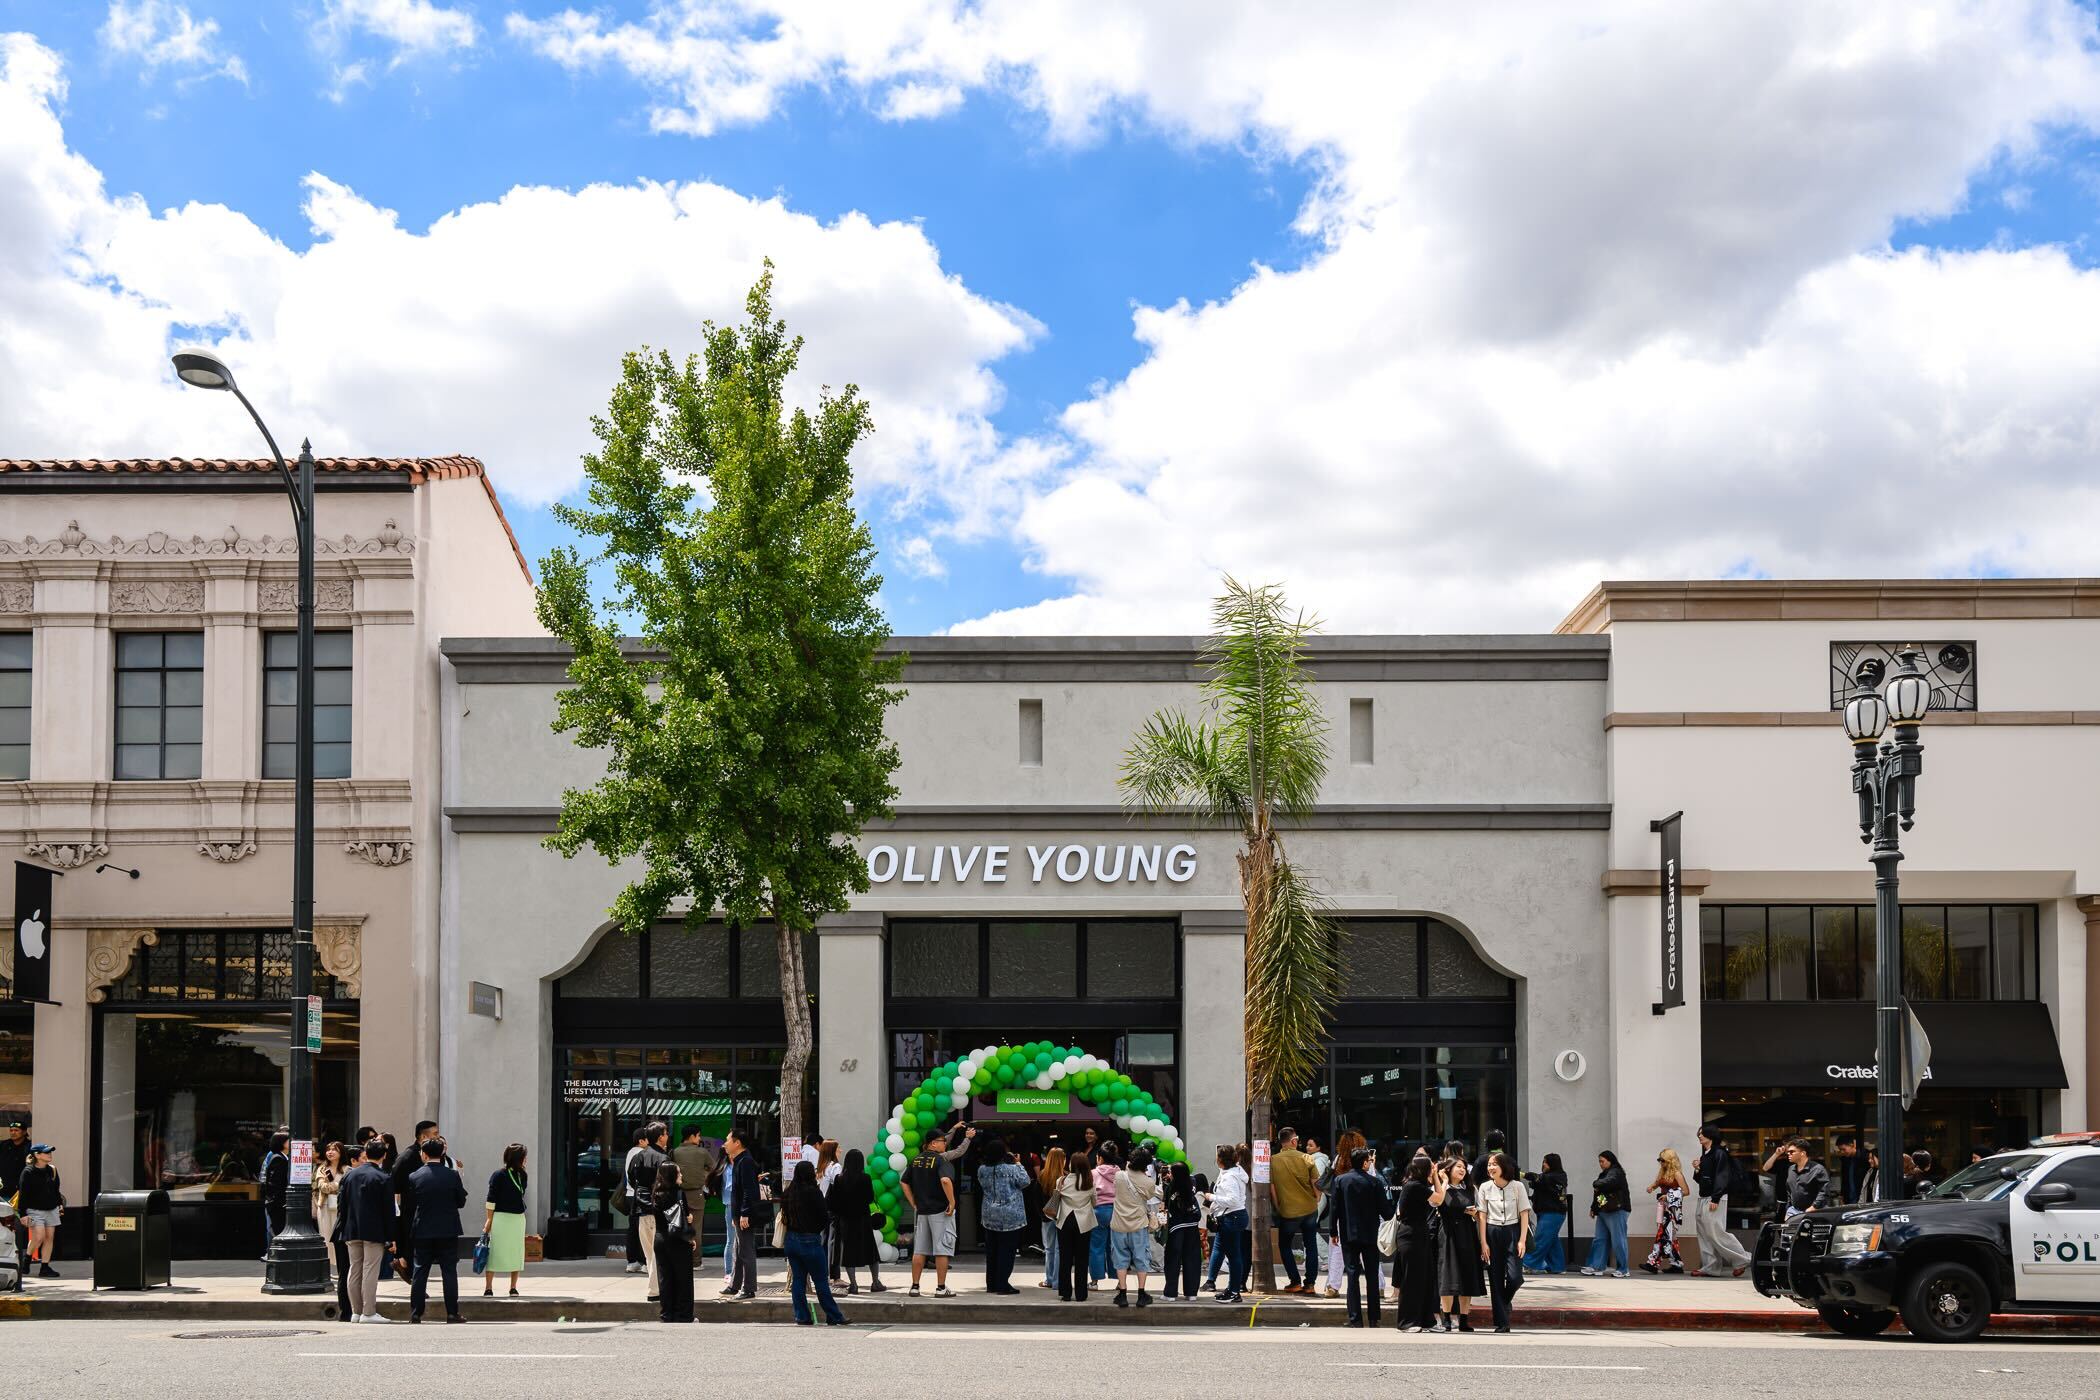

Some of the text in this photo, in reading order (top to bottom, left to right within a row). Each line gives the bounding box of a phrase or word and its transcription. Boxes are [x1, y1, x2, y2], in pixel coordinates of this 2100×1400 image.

[867, 844, 1197, 883] OLIVE YOUNG
[1666, 858, 1676, 990] Crate&Barrel
[840, 1059, 857, 1072] 58
[300, 1149, 309, 1157] NO
[784, 1152, 802, 1160] PARKI
[292, 1156, 312, 1164] PARKIN
[1890, 1214, 1910, 1223] 56
[2033, 1240, 2097, 1262] POL
